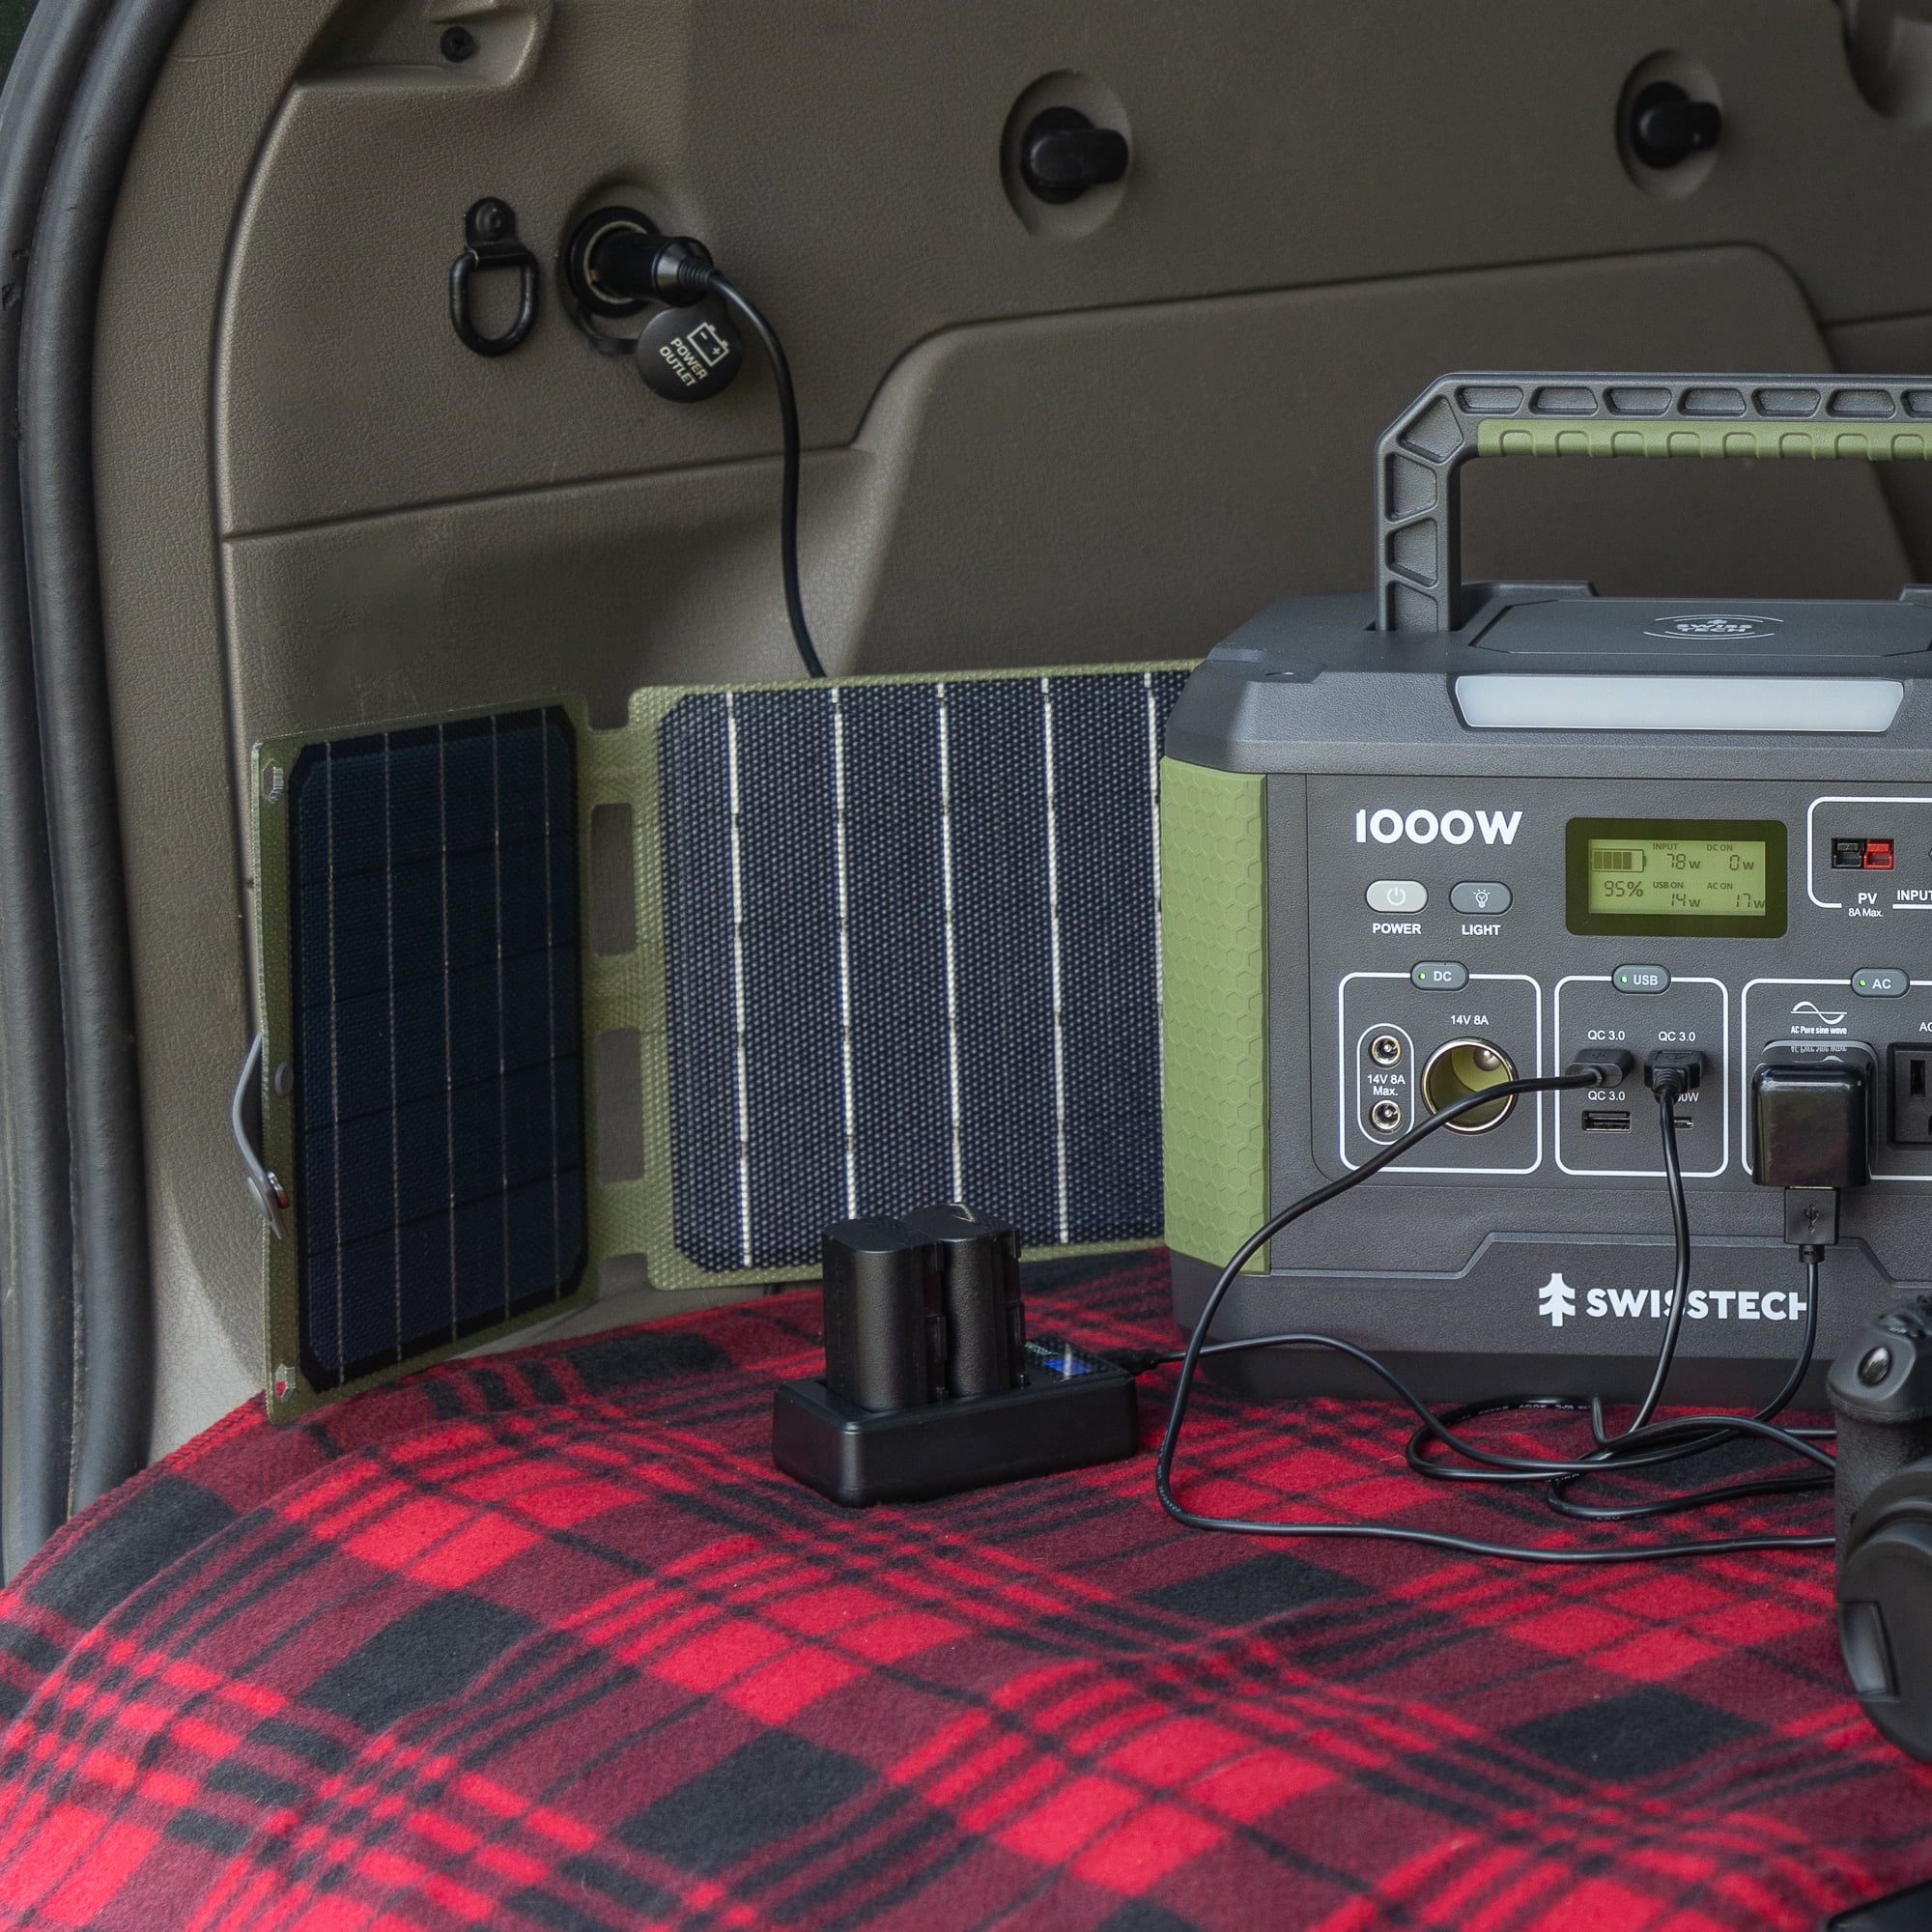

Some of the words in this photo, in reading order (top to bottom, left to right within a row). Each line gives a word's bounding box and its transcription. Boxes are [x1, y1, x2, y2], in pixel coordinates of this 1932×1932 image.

[670, 337, 708, 380] POWER
[659, 346, 696, 386] OUTLET
[1355, 809, 1523, 845] 1000W
[1652, 842, 1679, 851] INPUT
[1719, 843, 1734, 852] ON
[1604, 880, 1643, 897] 95%
[1652, 881, 1669, 890] USB
[1670, 881, 1684, 890] ON
[1719, 882, 1734, 891] ON
[1858, 893, 1878, 905] PV
[1848, 907, 1861, 918] 8A
[1861, 907, 1885, 918] Max.
[1372, 923, 1422, 935] POWER
[1462, 923, 1501, 936] LIGHT
[1433, 970, 1453, 982] DC
[1633, 974, 1659, 986] USB
[1871, 978, 1892, 990] AC
[1451, 1014, 1471, 1026] 14V
[1473, 1014, 1490, 1026] 8A
[1587, 1030, 1606, 1041] QC
[1607, 1030, 1626, 1040] 3.0
[1790, 1025, 1800, 1035] AC
[1800, 1025, 1815, 1035] Pure
[1815, 1025, 1830, 1035] sine
[1658, 1031, 1677, 1042] QC
[1678, 1031, 1696, 1041] 3.0
[1367, 1074, 1388, 1085] 14V
[1390, 1074, 1406, 1085] 8A
[1372, 1086, 1399, 1096] Max.
[1587, 1090, 1606, 1101] QC
[1607, 1090, 1626, 1101] 3.0
[1677, 1092, 1699, 1102] 0W
